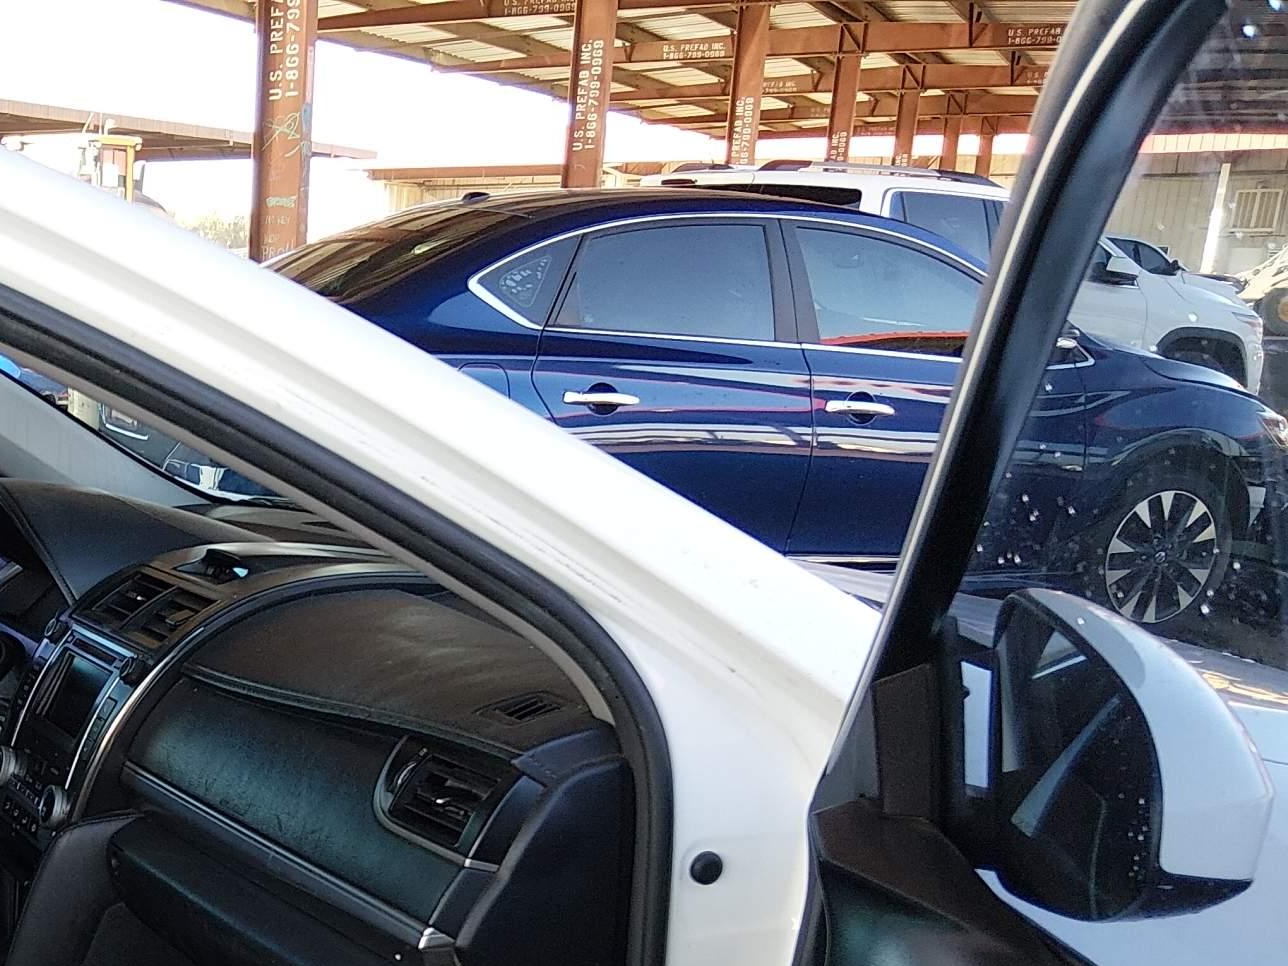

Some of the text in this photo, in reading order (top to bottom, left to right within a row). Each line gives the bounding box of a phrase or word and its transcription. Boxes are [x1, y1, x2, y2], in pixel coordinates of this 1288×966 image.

[269, 63, 283, 101] U.S.
[680, 43, 709, 52] PREFAB
[572, 39, 593, 151] U.S. PREFAB INC.
[584, 39, 604, 149] 1-866-799-0969
